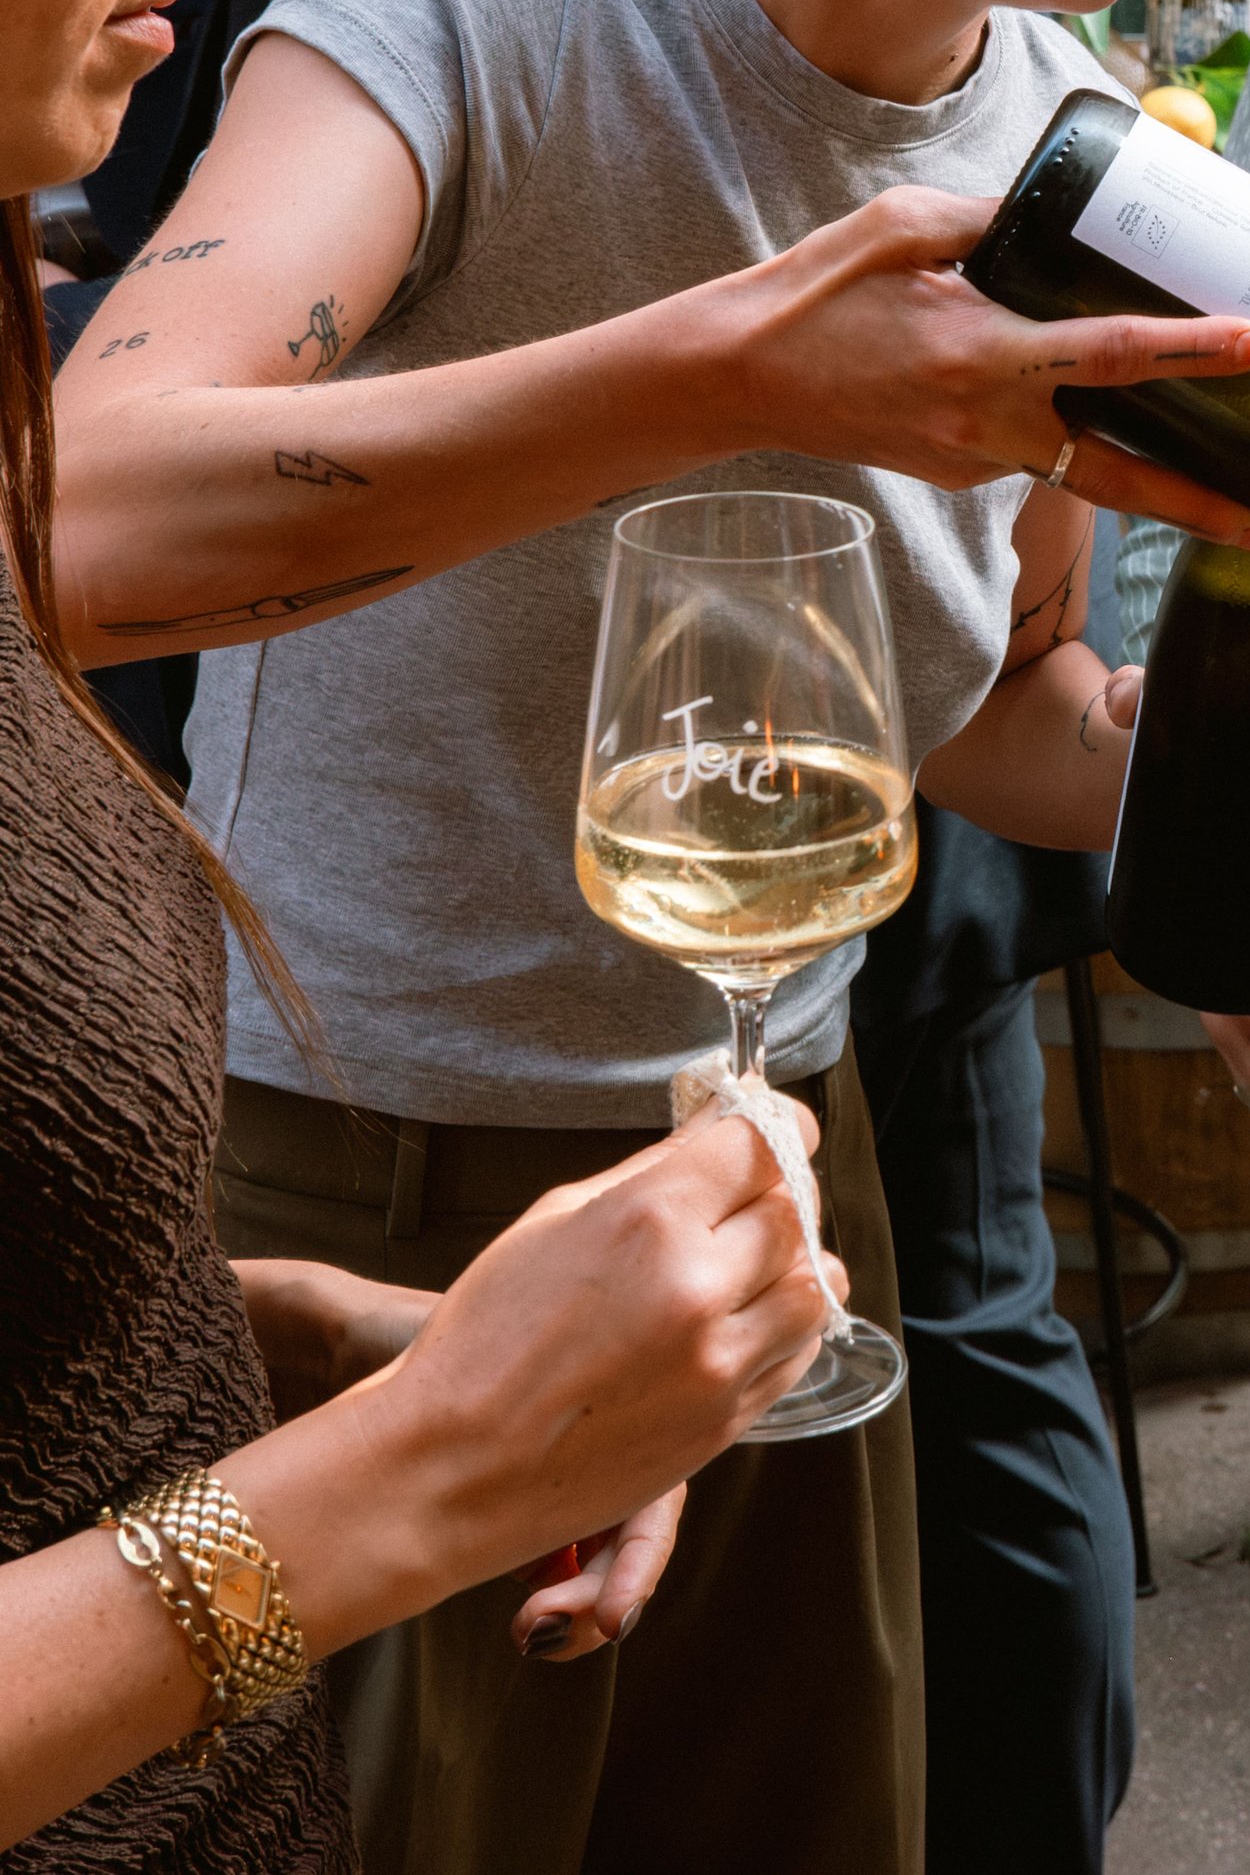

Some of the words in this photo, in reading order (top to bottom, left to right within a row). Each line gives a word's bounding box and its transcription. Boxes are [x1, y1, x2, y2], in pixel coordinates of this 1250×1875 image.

[1116, 202, 1131, 222] France
[1119, 201, 1140, 232] Agriculture
[99, 331, 150, 359] 26
[661, 694, 783, 804] Joie
